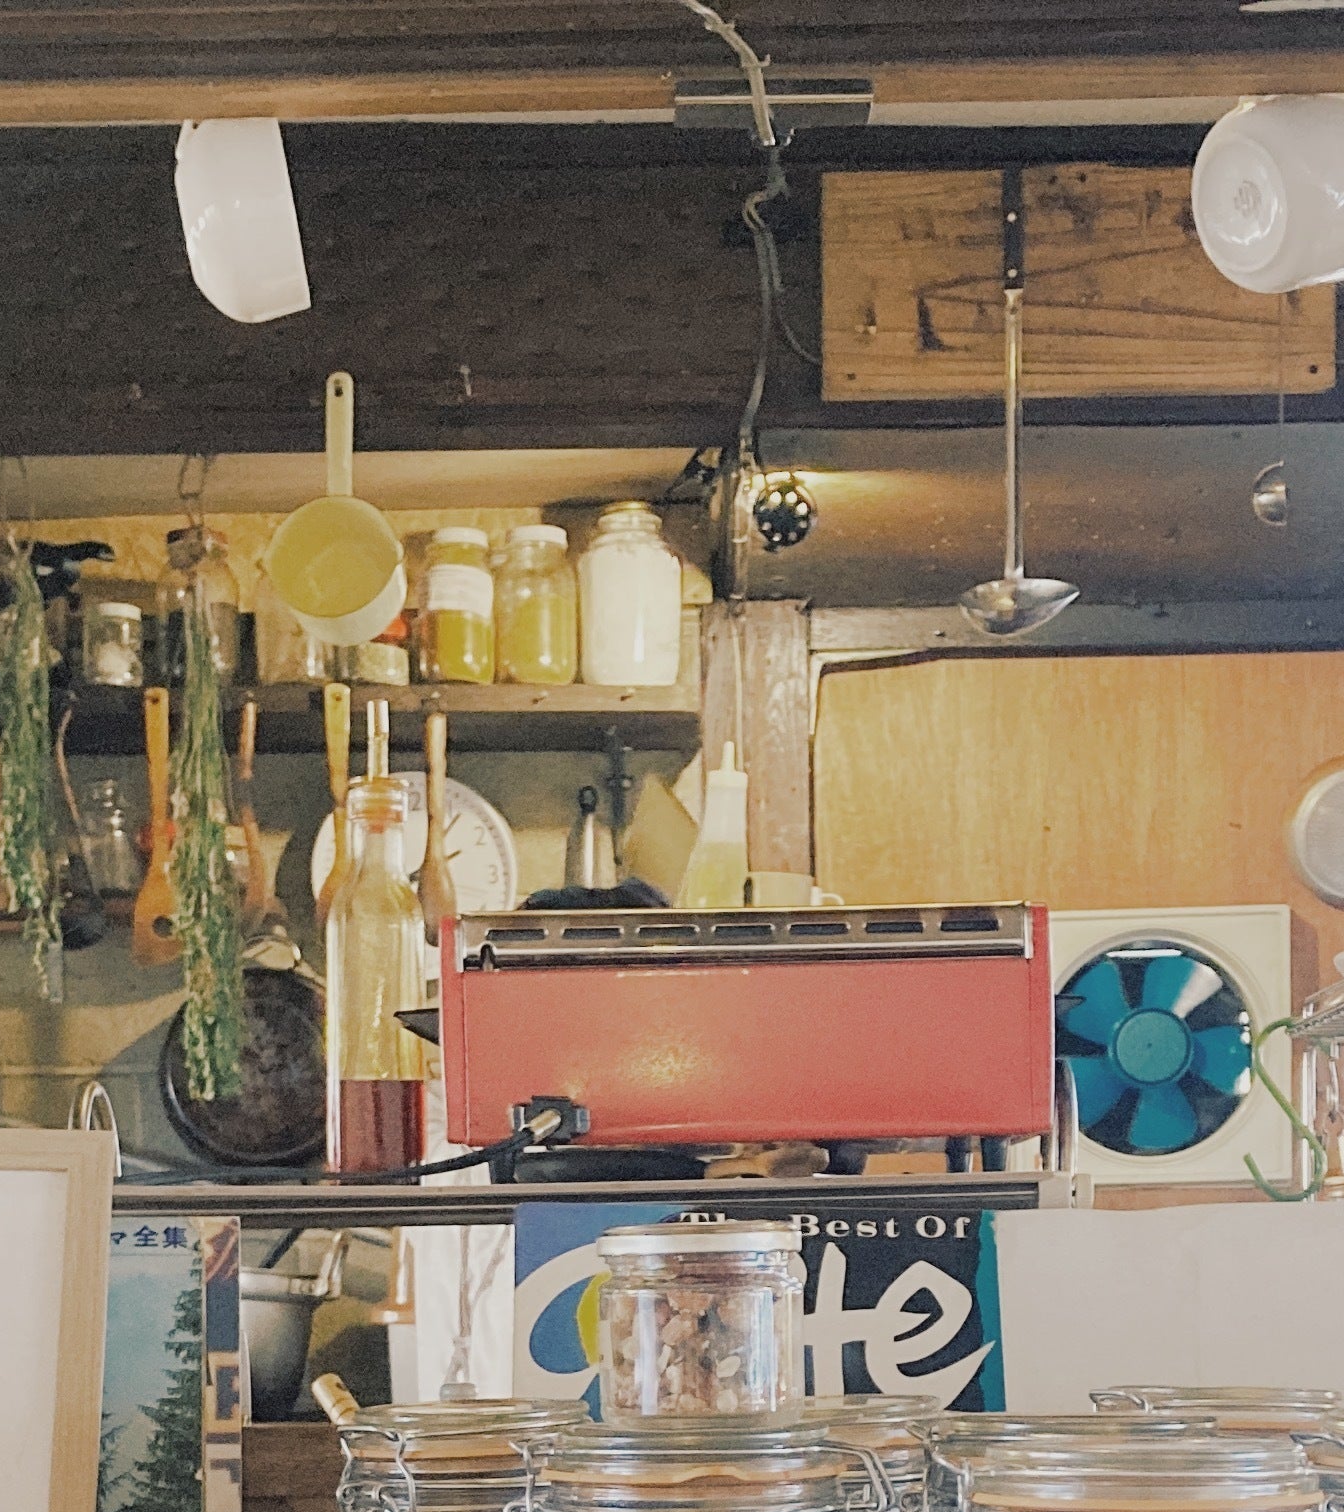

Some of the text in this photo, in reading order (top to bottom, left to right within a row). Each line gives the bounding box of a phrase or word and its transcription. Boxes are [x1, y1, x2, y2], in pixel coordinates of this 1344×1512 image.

[473, 825, 487, 846] 2
[488, 864, 499, 884] 3
[914, 1214, 971, 1239] Of
